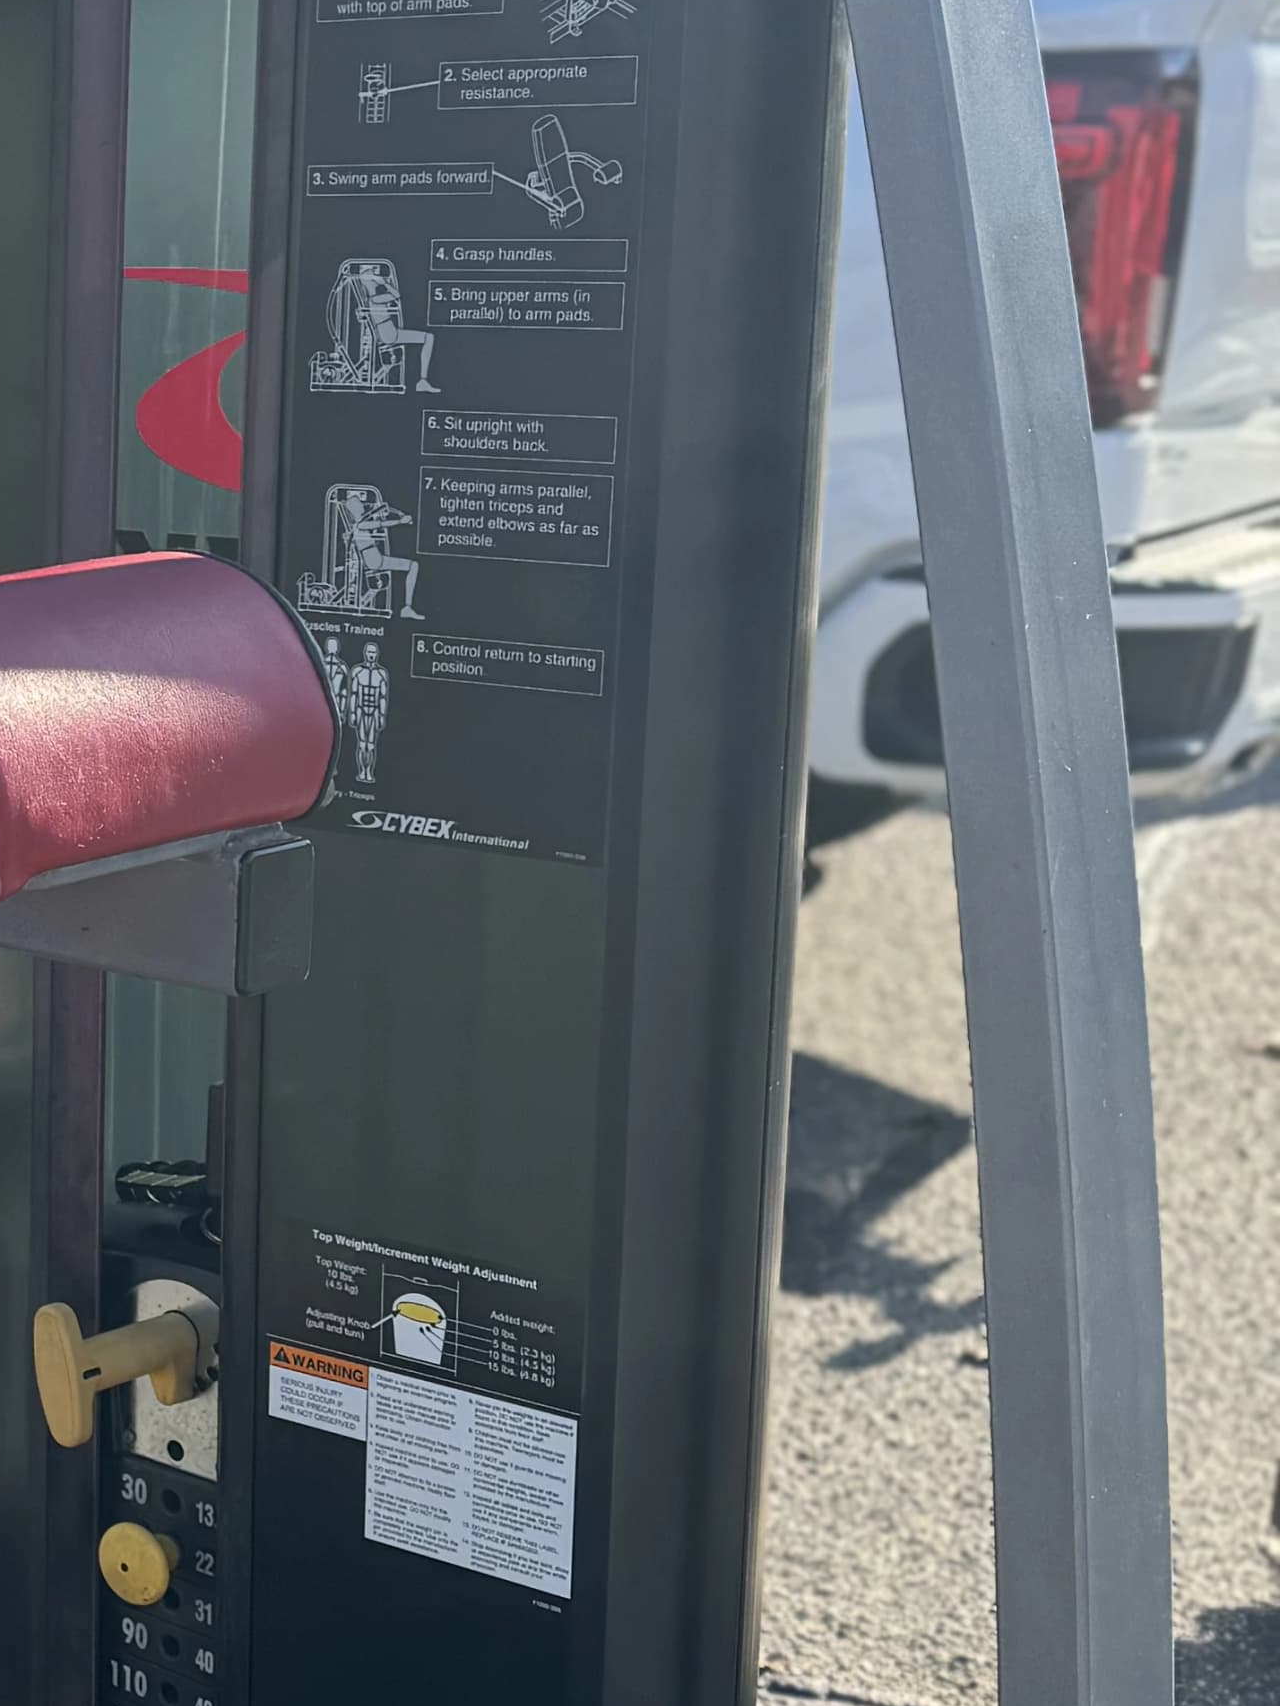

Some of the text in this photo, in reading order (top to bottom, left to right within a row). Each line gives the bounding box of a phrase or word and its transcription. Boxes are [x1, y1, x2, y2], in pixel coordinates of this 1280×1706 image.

[444, 65, 588, 83] 2. Select appropriate
[460, 86, 534, 100] resistance.
[312, 169, 491, 188] 3. Swing arm pads forward.
[436, 246, 556, 264] 4. Grasp handles.
[434, 287, 591, 306] 5. Bring upper arms (in
[508, 308, 521, 321] to
[525, 309, 552, 321] arm
[556, 308, 594, 324] pads.
[427, 415, 544, 435] 6. Sit upright with
[443, 435, 549, 452] shoulders back.
[424, 477, 592, 500] 7. Keeping arms parallel,
[439, 496, 564, 516] tighten triceps and
[439, 515, 599, 536] extend elbows as far as
[438, 533, 496, 547] possible.
[305, 621, 384, 636] uscles Trained
[416, 640, 597, 672] 8. Control return to starting
[382, 812, 530, 850] CYBEX International
[312, 1228, 538, 1291] Top Weight/Increment Weight Adjustment
[316, 1255, 333, 1267] Top
[306, 1306, 371, 1330] Adjusting Knob
[326, 1322, 343, 1334] and
[488, 1350, 499, 1361] 10
[292, 1353, 364, 1383] WARNING
[488, 1361, 499, 1373] 15
[121, 1473, 147, 1505] 30
[195, 1549, 215, 1577] 22
[195, 1599, 212, 1625] 31
[122, 1617, 148, 1650] 90
[195, 1648, 214, 1674] 40
[110, 1659, 148, 1698] 110
